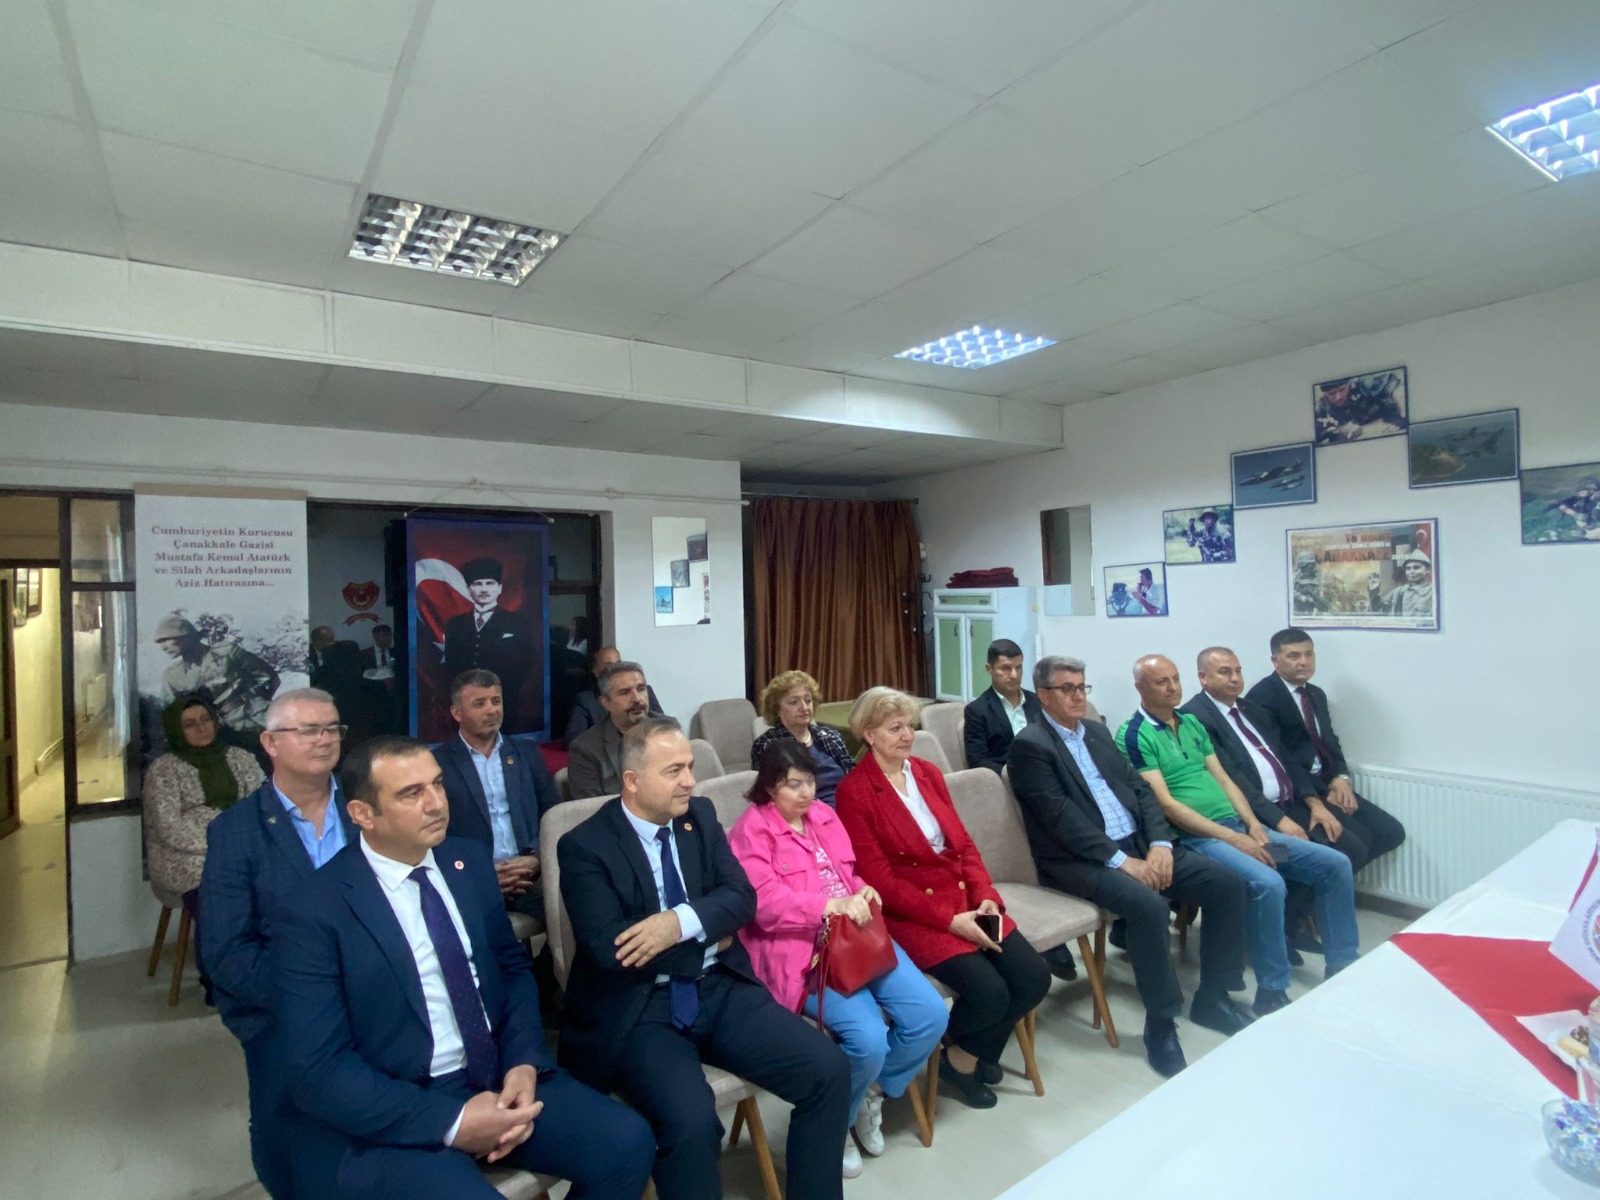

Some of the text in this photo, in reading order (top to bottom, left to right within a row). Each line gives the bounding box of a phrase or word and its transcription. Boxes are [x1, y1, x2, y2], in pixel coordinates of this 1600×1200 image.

[151, 526, 293, 537] Cumhuriyetin Kurucusu
[173, 539, 274, 550] Çanakkale Gazisi
[155, 552, 291, 562] Mustafa Kemal Atatürk
[154, 566, 292, 576] ve Silah Arkadaşlarının
[175, 578, 275, 588] Aziz Hatırasına...
